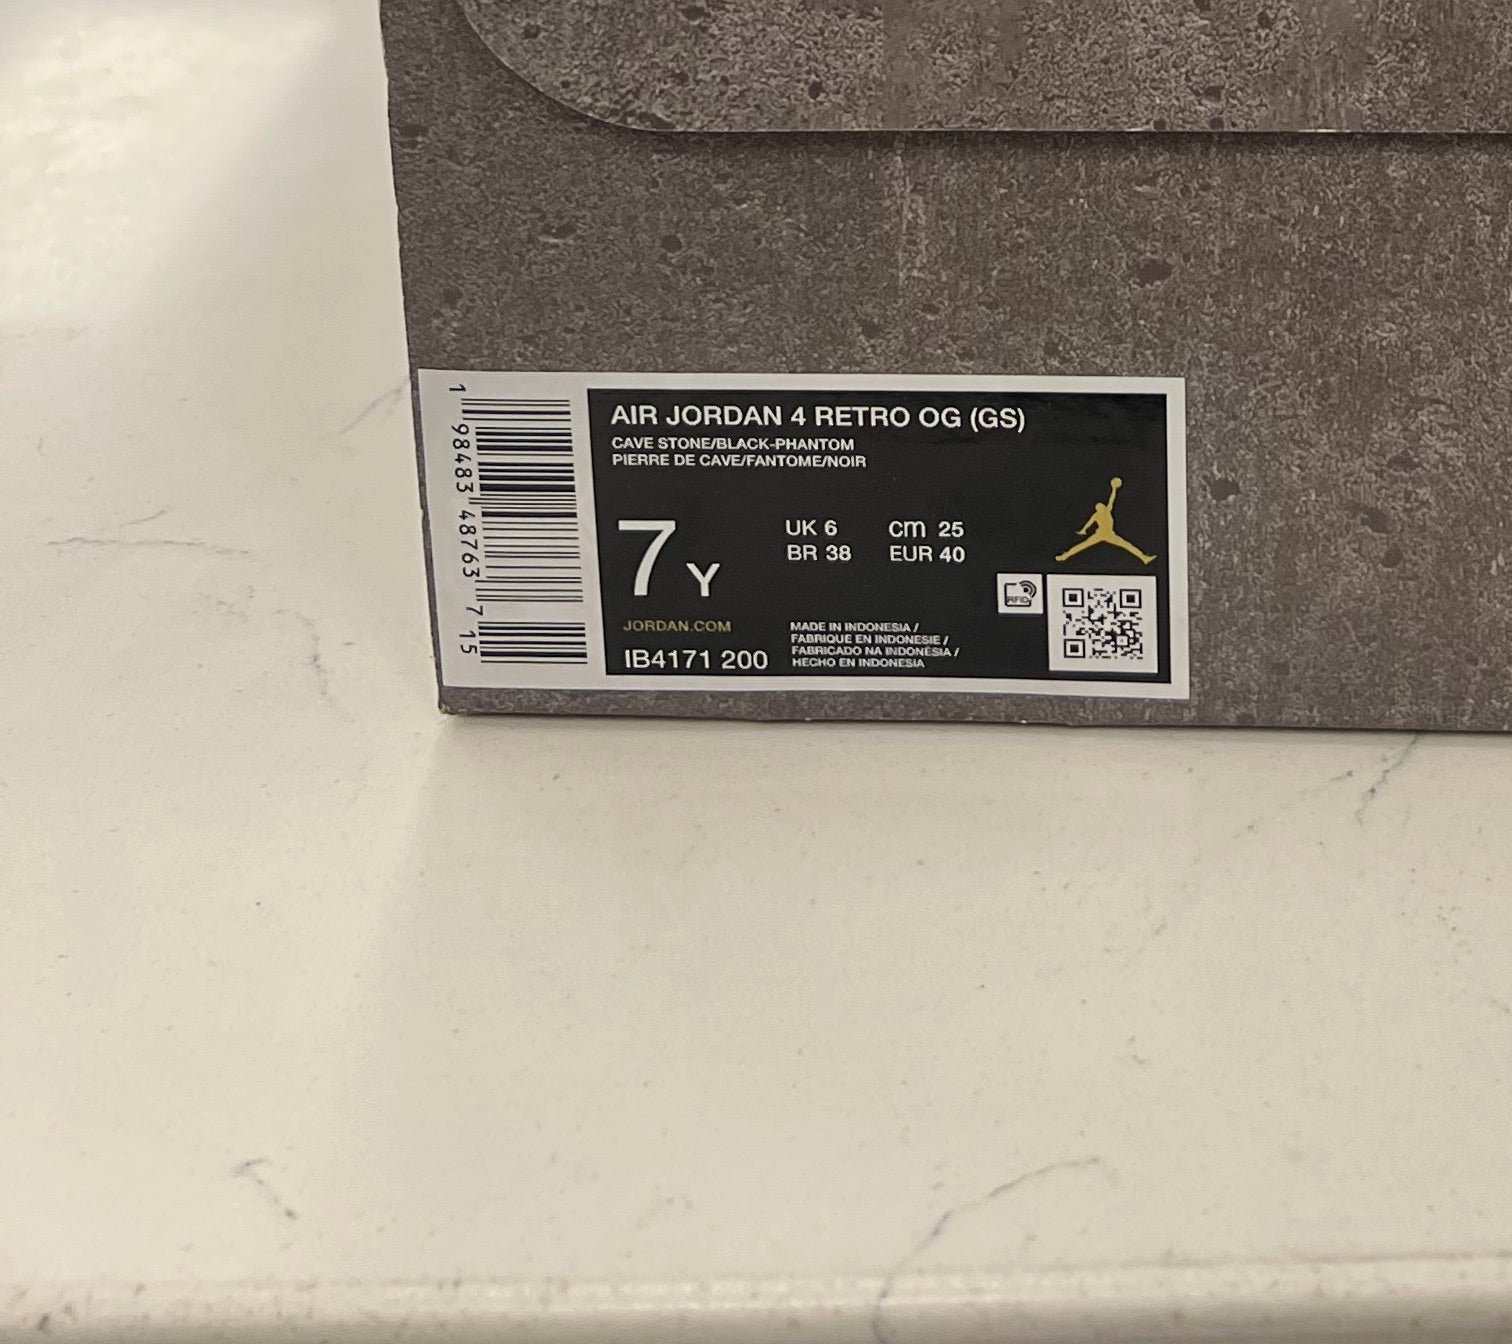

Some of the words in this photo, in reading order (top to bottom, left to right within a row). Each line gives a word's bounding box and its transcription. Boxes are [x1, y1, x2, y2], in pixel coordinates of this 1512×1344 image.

[611, 405, 658, 425] AIR
[666, 405, 782, 426] JORDAN
[791, 406, 806, 426] 4
[815, 406, 910, 428] RETRO
[918, 406, 962, 428] OG
[970, 407, 1025, 433] (GS)
[611, 437, 654, 450] CAVE
[658, 437, 855, 451] STONE/BLACK-PHANTOM
[451, 423, 474, 493] 98483
[613, 454, 670, 466] PIERRE
[674, 454, 696, 466] DE
[700, 454, 867, 468] CAVE/FANTOME/NOIR
[786, 520, 817, 536] UK
[824, 520, 837, 536] 6
[938, 521, 964, 538] 25
[458, 509, 481, 578] 48763
[618, 520, 676, 596] 7
[686, 563, 720, 597] Y
[787, 544, 818, 560] BR
[825, 545, 852, 561] 38
[890, 545, 933, 562] EUR
[939, 546, 966, 563] 40
[466, 605, 483, 616] 7
[623, 620, 731, 632] JORDAN.COM
[790, 622, 826, 631] MADE
[829, 622, 841, 631] IN
[845, 623, 911, 632] INDONESIA
[459, 630, 478, 654] 15
[791, 634, 852, 644] FABRIQUE
[856, 635, 871, 644] EN
[875, 635, 941, 645] INDONESIE
[792, 646, 862, 655] FABRICADO
[865, 647, 882, 655] NA
[625, 649, 710, 669] IB4171
[721, 650, 768, 670] 200
[792, 658, 836, 667] HECHO
[839, 658, 855, 667] EN
[859, 658, 925, 668] INDONESIA
